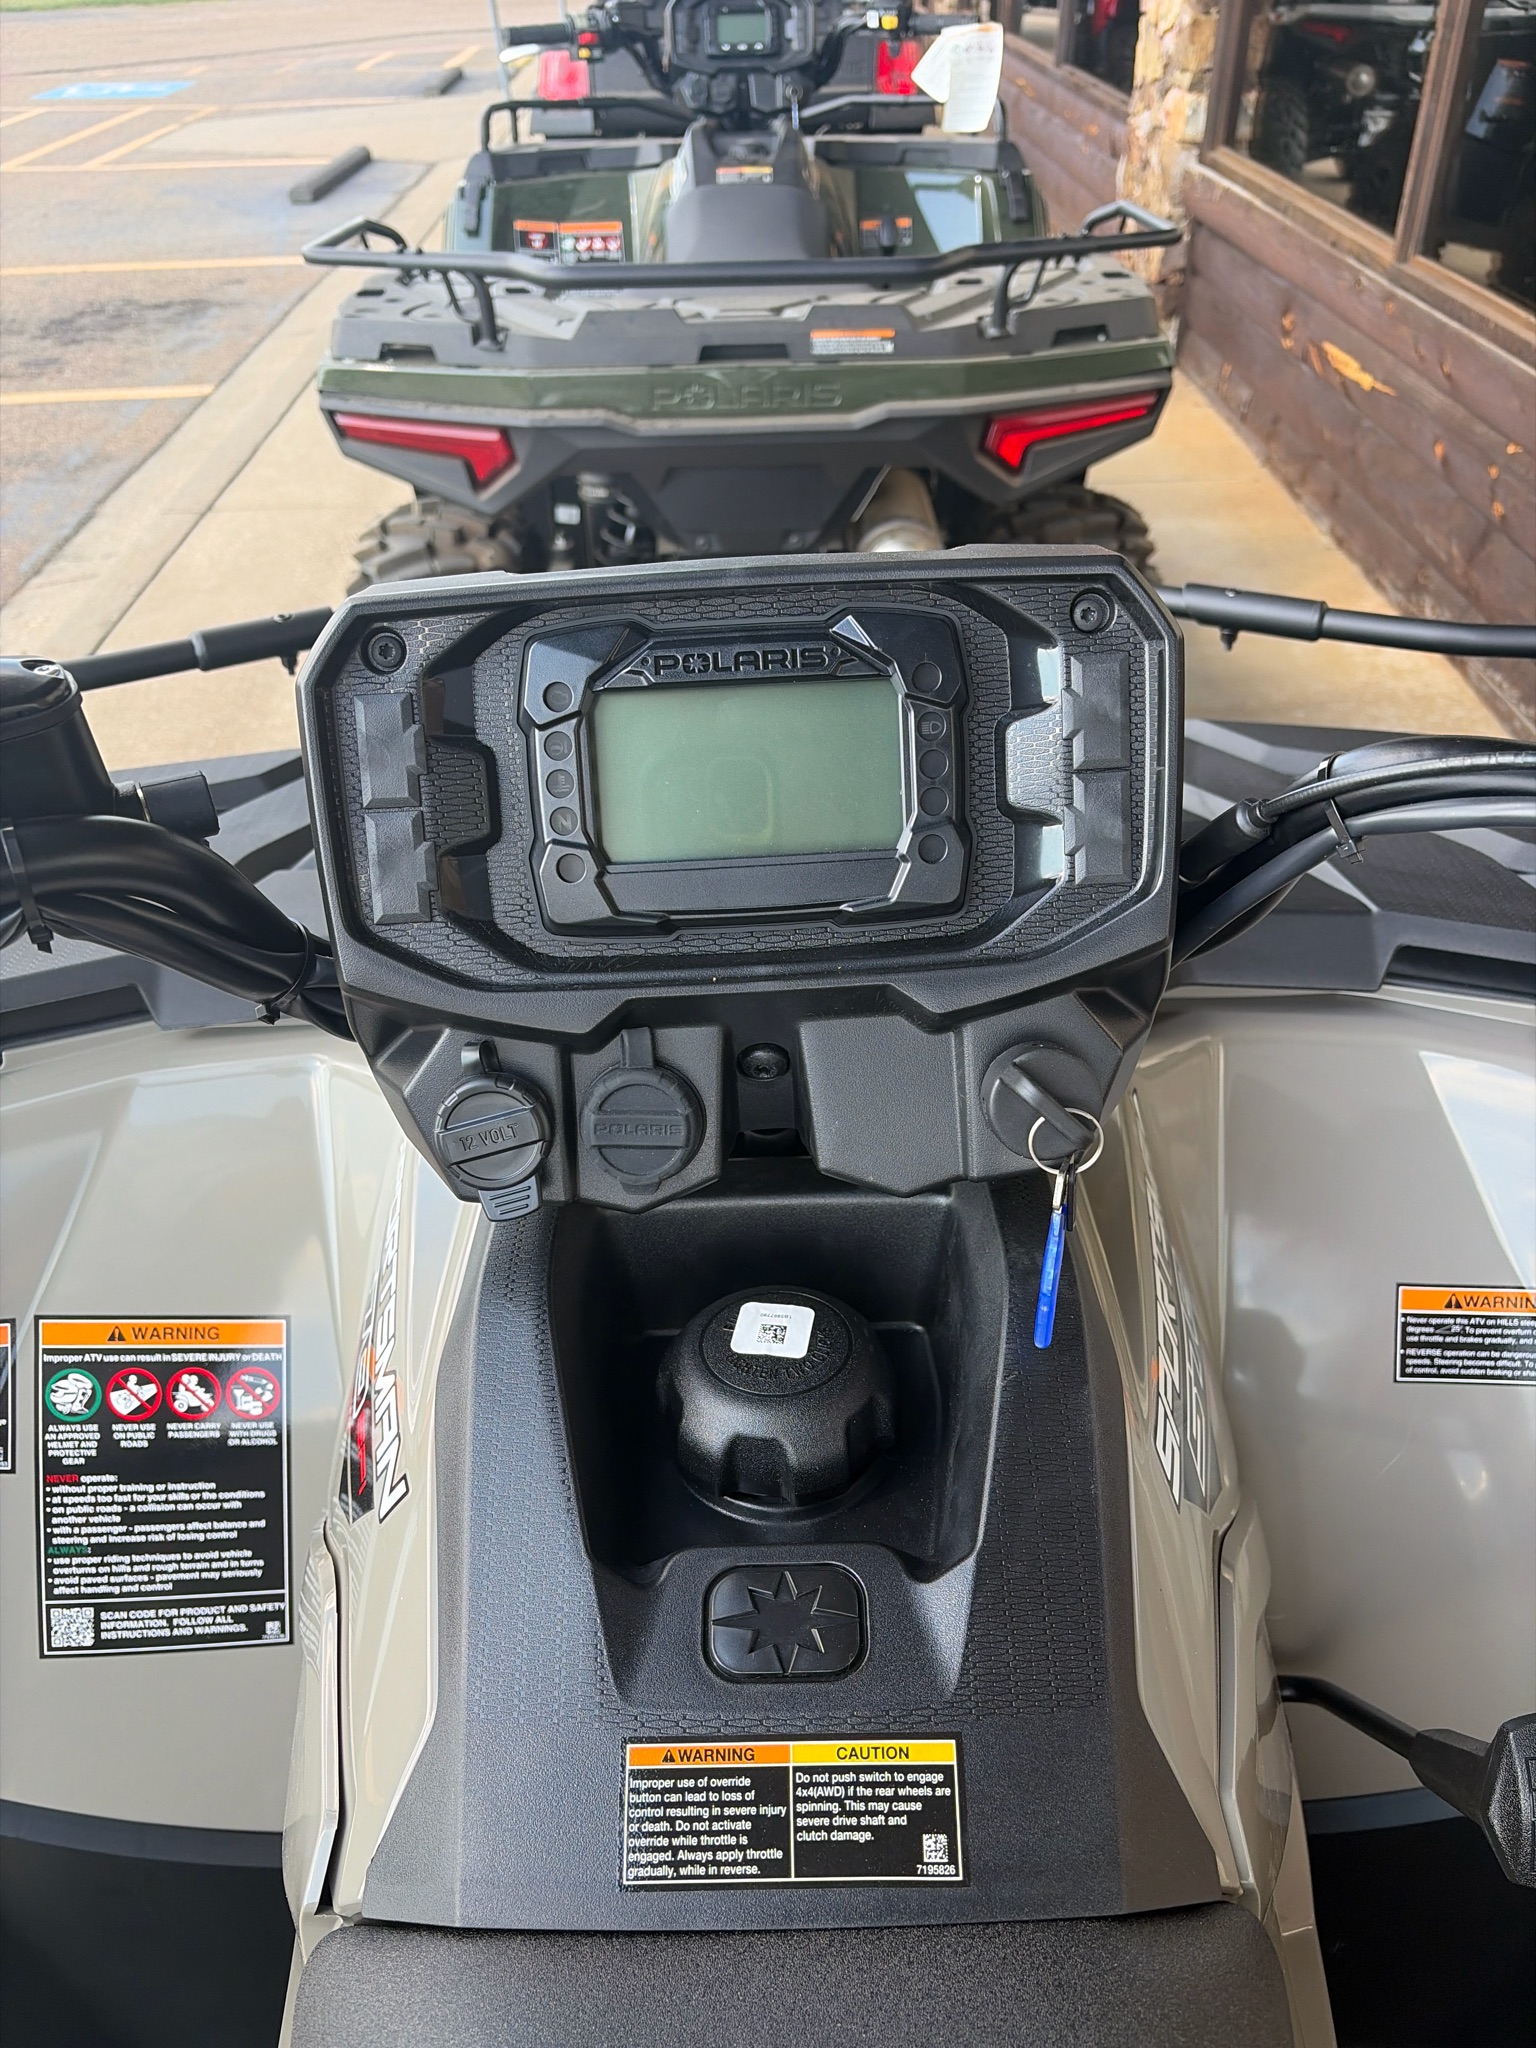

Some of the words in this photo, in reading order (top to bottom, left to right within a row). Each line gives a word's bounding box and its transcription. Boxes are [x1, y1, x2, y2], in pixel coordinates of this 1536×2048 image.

[652, 381, 843, 411] POLARIS
[654, 646, 830, 676] POLARIS
[594, 1123, 683, 1137] POLARIS
[458, 1137, 479, 1152] 12
[480, 1123, 519, 1146] VOLT
[1407, 1316, 1427, 1324] Never
[1429, 1317, 1455, 1325] operate
[1456, 1317, 1468, 1325] this
[1470, 1317, 1485, 1325] ATV
[133, 1327, 219, 1340] WARNING
[43, 1354, 82, 1363] Improper
[84, 1353, 102, 1362] ATV
[171, 1353, 207, 1361] SEVERE
[208, 1353, 241, 1361] INJURY
[252, 1353, 282, 1361] DEATH
[1406, 1348, 1442, 1356] REVERSE
[1443, 1350, 1475, 1358] operation
[48, 1424, 82, 1432] ALWAYS
[58, 1432, 100, 1440] APPROVED
[168, 1431, 220, 1439] PASSENGERS
[120, 1440, 148, 1448] ROADS
[242, 1438, 278, 1446] ALCOHOL
[48, 1449, 97, 1457] PROTECTIVE
[47, 1475, 78, 1483] NEVER
[80, 1474, 118, 1485] operate:
[52, 1484, 86, 1494] without
[88, 1484, 117, 1494] proper
[120, 1483, 154, 1493] training
[168, 1482, 216, 1491] instruction
[53, 1557, 70, 1565] use
[72, 1556, 102, 1566] proper
[104, 1554, 130, 1565] riding
[132, 1552, 181, 1563] techniques
[194, 1551, 219, 1559] avoid
[221, 1550, 252, 1558] vehicle
[100, 1611, 127, 1620] SCAN
[129, 1610, 156, 1619] CODE
[158, 1609, 178, 1618] FOR
[180, 1607, 225, 1616] PRODUCT
[227, 1605, 248, 1614] AND
[250, 1603, 285, 1612] SAFETY
[100, 1621, 168, 1630] INFORMATION.
[173, 1617, 213, 1626] FOLLOW
[215, 1615, 233, 1624] ALL
[100, 1630, 170, 1640] INSTRUCTIONS
[172, 1628, 193, 1636] AND
[195, 1624, 248, 1634] WARNINGS.
[678, 1748, 755, 1762] WARNING
[837, 1747, 909, 1760] CAUTION
[629, 1778, 674, 1790] Improper
[677, 1779, 695, 1787] use
[698, 1777, 708, 1787] of
[711, 1776, 751, 1786] override
[796, 1772, 810, 1783] Do
[813, 1773, 829, 1782] not
[832, 1772, 856, 1784] push
[859, 1772, 891, 1782] switch
[894, 1773, 904, 1782] to
[907, 1773, 944, 1784] engage
[629, 1792, 661, 1803] button
[664, 1793, 682, 1802] can
[685, 1791, 706, 1802] lead
[709, 1792, 719, 1801] to
[722, 1791, 742, 1801] loss
[745, 1790, 755, 1800] of
[796, 1786, 845, 1798] 4x4(AWD)
[848, 1786, 854, 1796] if
[857, 1786, 872, 1796] the
[875, 1787, 895, 1796] rear
[898, 1786, 932, 1796] wheels
[935, 1787, 951, 1796] are
[629, 1806, 663, 1818] control
[666, 1806, 709, 1818] resulting
[712, 1805, 720, 1816] in
[724, 1806, 756, 1815] severe
[760, 1804, 786, 1817] injury
[796, 1801, 841, 1813] spinning.
[844, 1800, 865, 1811] This
[868, 1802, 889, 1813] may
[892, 1801, 922, 1810] cause
[629, 1823, 640, 1832] or
[642, 1821, 672, 1831] death.
[676, 1820, 690, 1831] Do
[693, 1821, 709, 1830] not
[712, 1820, 751, 1830] activate
[797, 1816, 830, 1826] severe
[833, 1815, 857, 1825] drive
[860, 1815, 885, 1825] shaft
[888, 1814, 907, 1825] and
[629, 1836, 669, 1847] override
[672, 1836, 697, 1846] while
[700, 1835, 737, 1845] throttle
[739, 1834, 748, 1845] is
[797, 1831, 827, 1841] clutch
[830, 1830, 874, 1843] damage.
[628, 1850, 674, 1864] engaged.
[677, 1850, 713, 1862] Always
[716, 1850, 744, 1861] apply
[746, 1849, 783, 1859] throttle
[628, 1865, 676, 1878] gradually,
[680, 1865, 705, 1875] while
[709, 1864, 717, 1875] in
[720, 1865, 760, 1875] reverse.
[916, 1865, 955, 1875] 7195826
